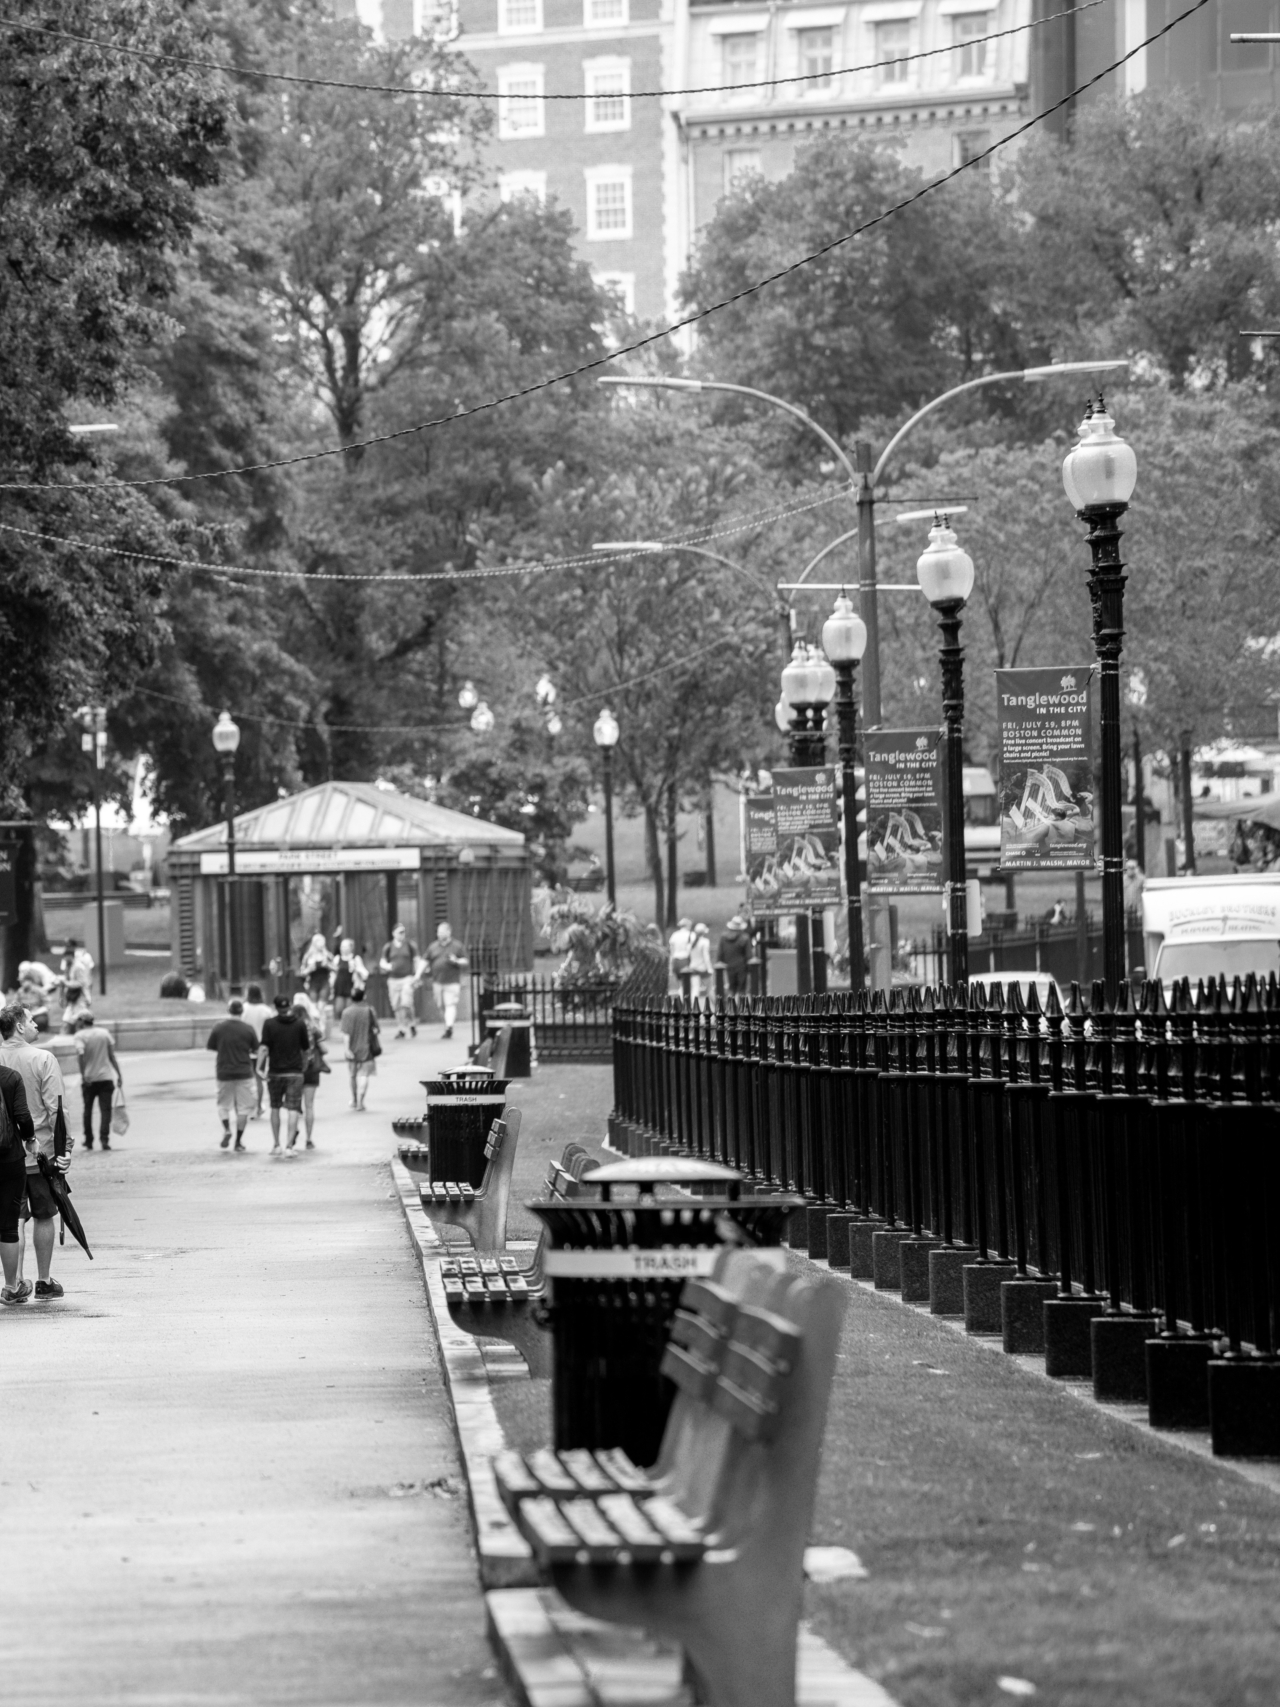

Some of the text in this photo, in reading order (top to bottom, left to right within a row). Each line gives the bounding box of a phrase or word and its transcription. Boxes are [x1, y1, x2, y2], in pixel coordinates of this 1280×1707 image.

[1002, 690, 1087, 708] Tanglewood
[1049, 706, 1065, 714] THE
[1003, 730, 1038, 738] BOSTON
[869, 749, 937, 764] Tanglewood
[776, 783, 834, 797] Tanglewood
[750, 810, 775, 821] Tangle
[1169, 904, 1276, 922] BUCKLEY BROTHERS
[634, 1256, 698, 1270] TRASH
